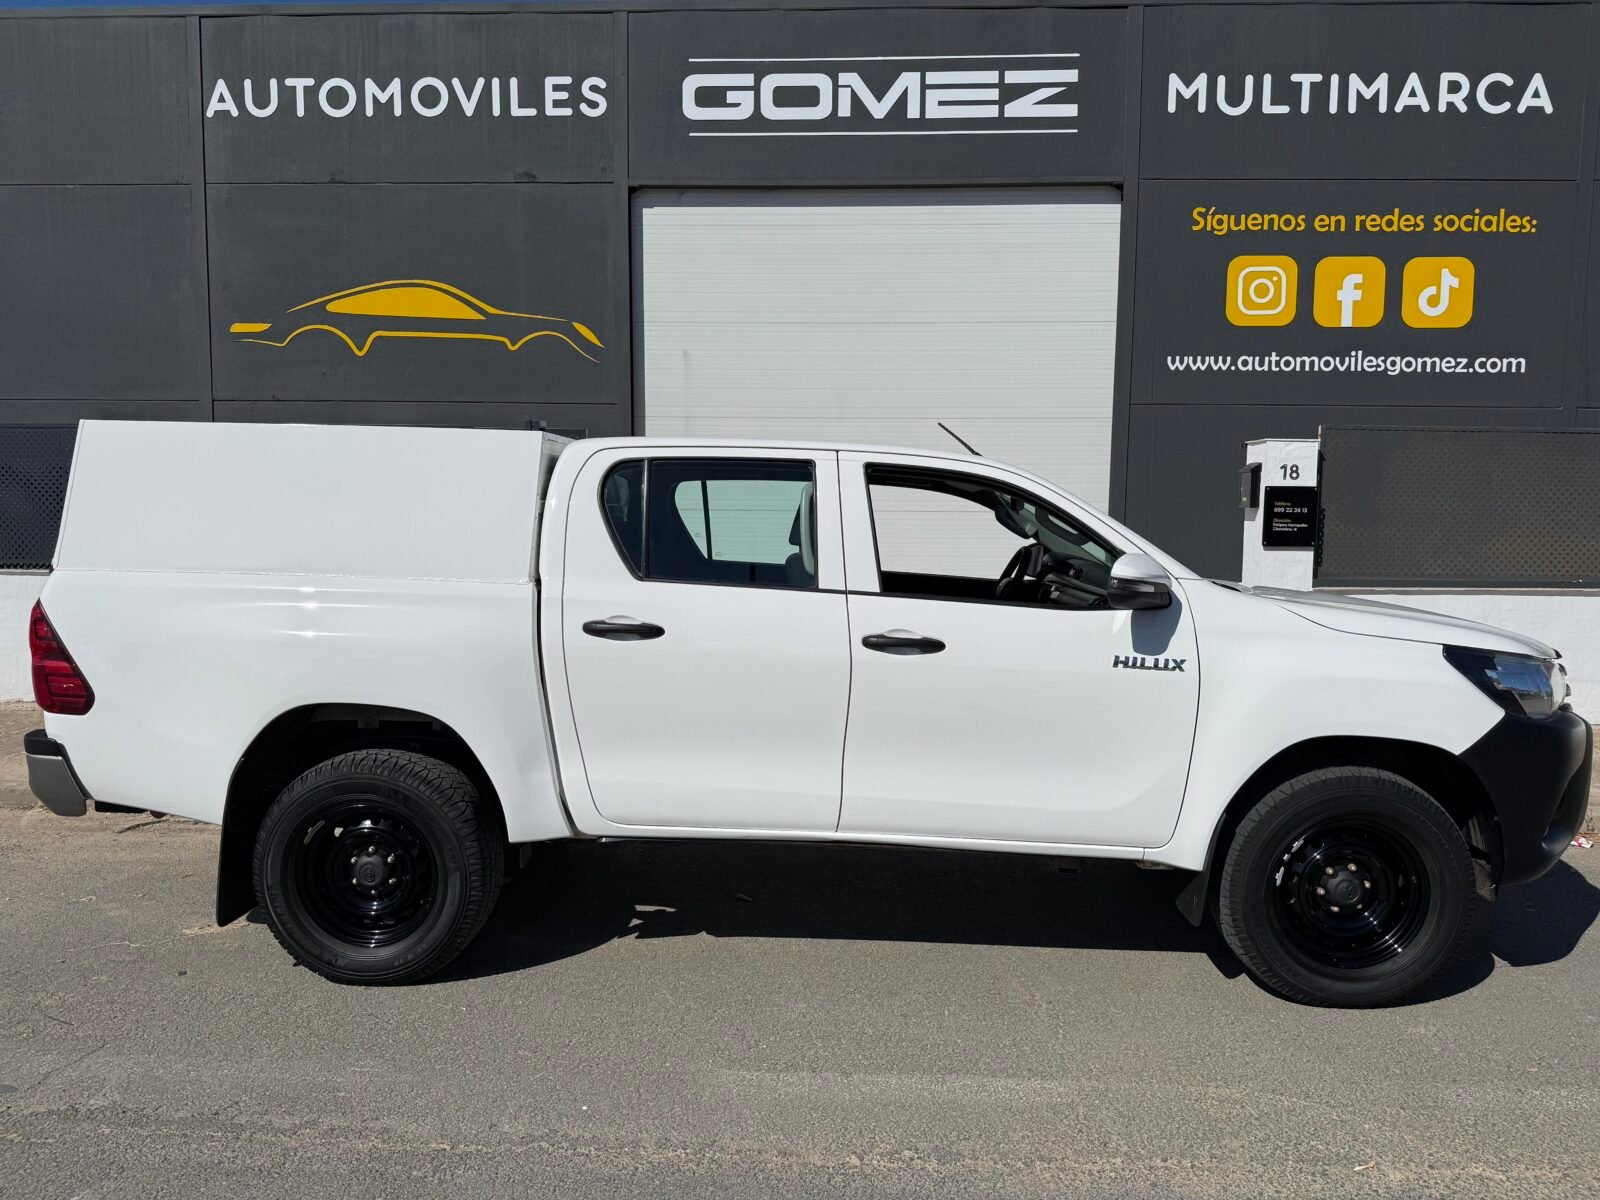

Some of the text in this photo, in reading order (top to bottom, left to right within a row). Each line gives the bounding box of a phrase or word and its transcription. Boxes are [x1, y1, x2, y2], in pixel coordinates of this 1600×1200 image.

[205, 75, 608, 118] AUTOMOVILES
[682, 69, 1079, 121] GOMEZ
[1167, 71, 1554, 116] MULTIMARCA
[1192, 206, 1537, 235] Síguenos en redes sociales:
[1166, 350, 1526, 376] www.automovilesgomez.com
[1279, 463, 1300, 481] 18
[1112, 655, 1187, 672] HILUX
